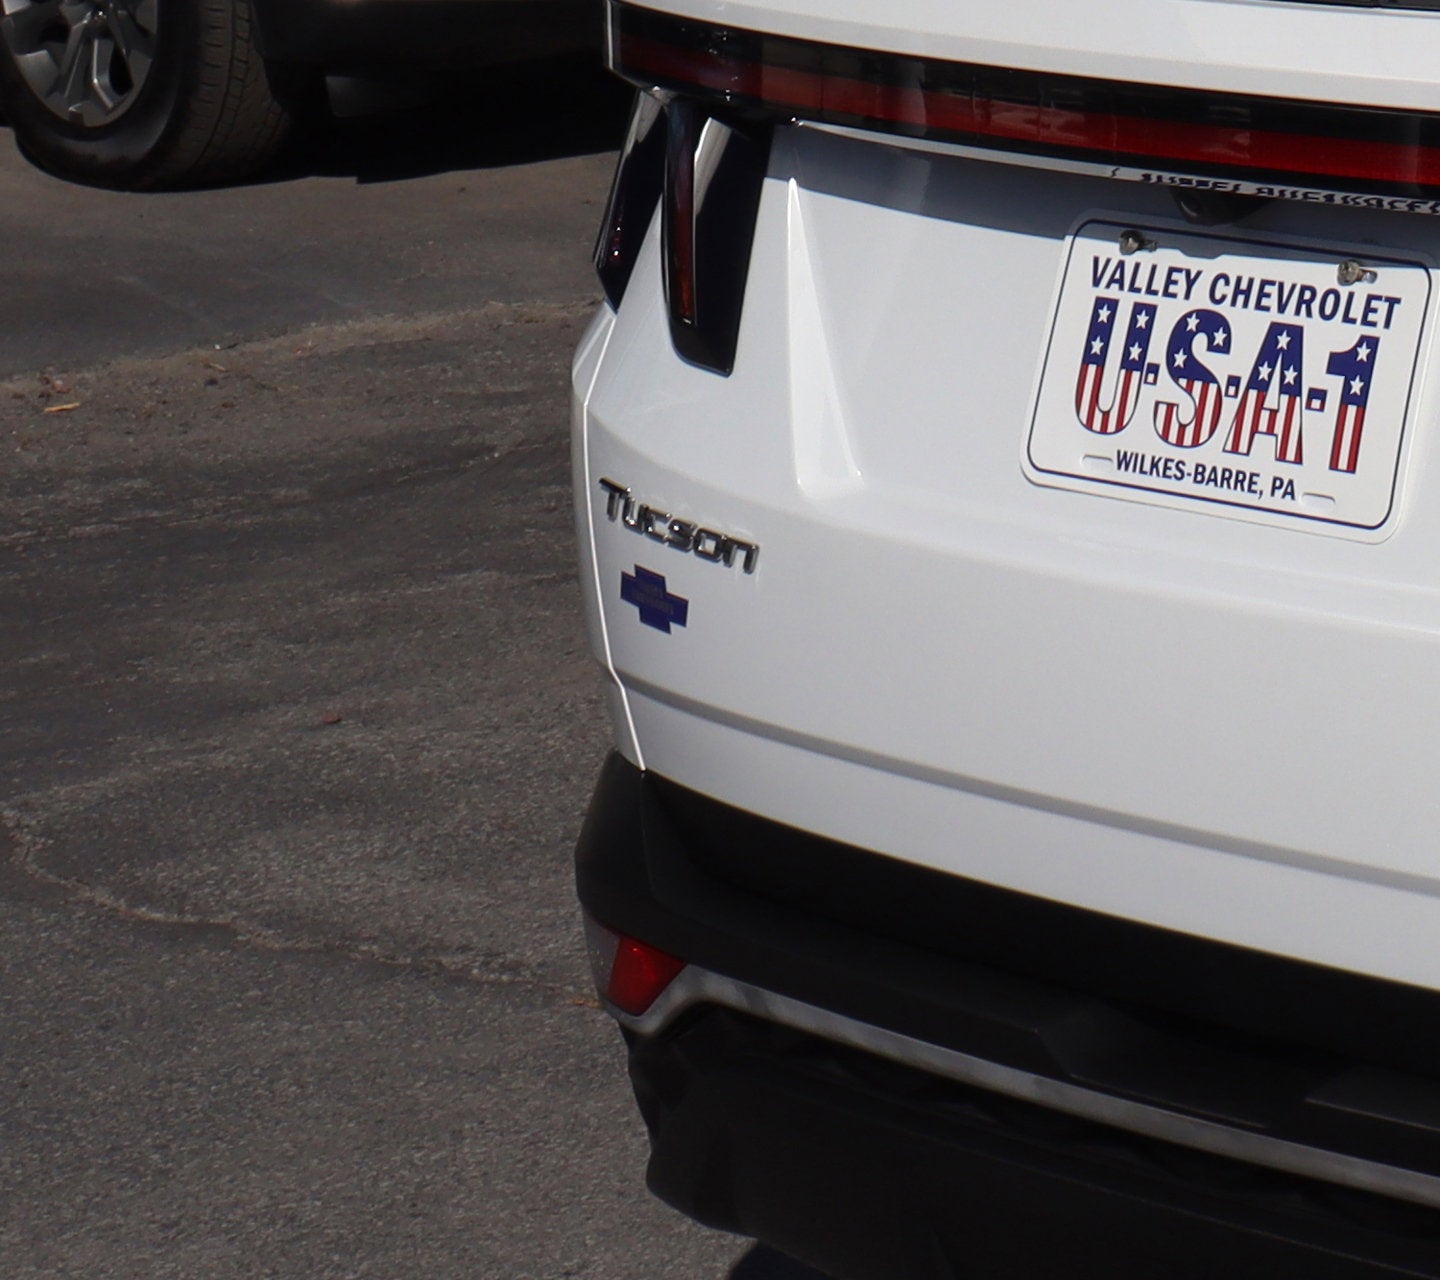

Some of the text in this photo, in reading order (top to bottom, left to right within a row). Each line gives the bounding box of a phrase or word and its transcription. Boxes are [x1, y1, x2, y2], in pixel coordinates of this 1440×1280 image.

[1091, 256, 1401, 330] VALLEY CHEVROLET
[1117, 450, 1296, 501] WILKES-BARRE, PA
